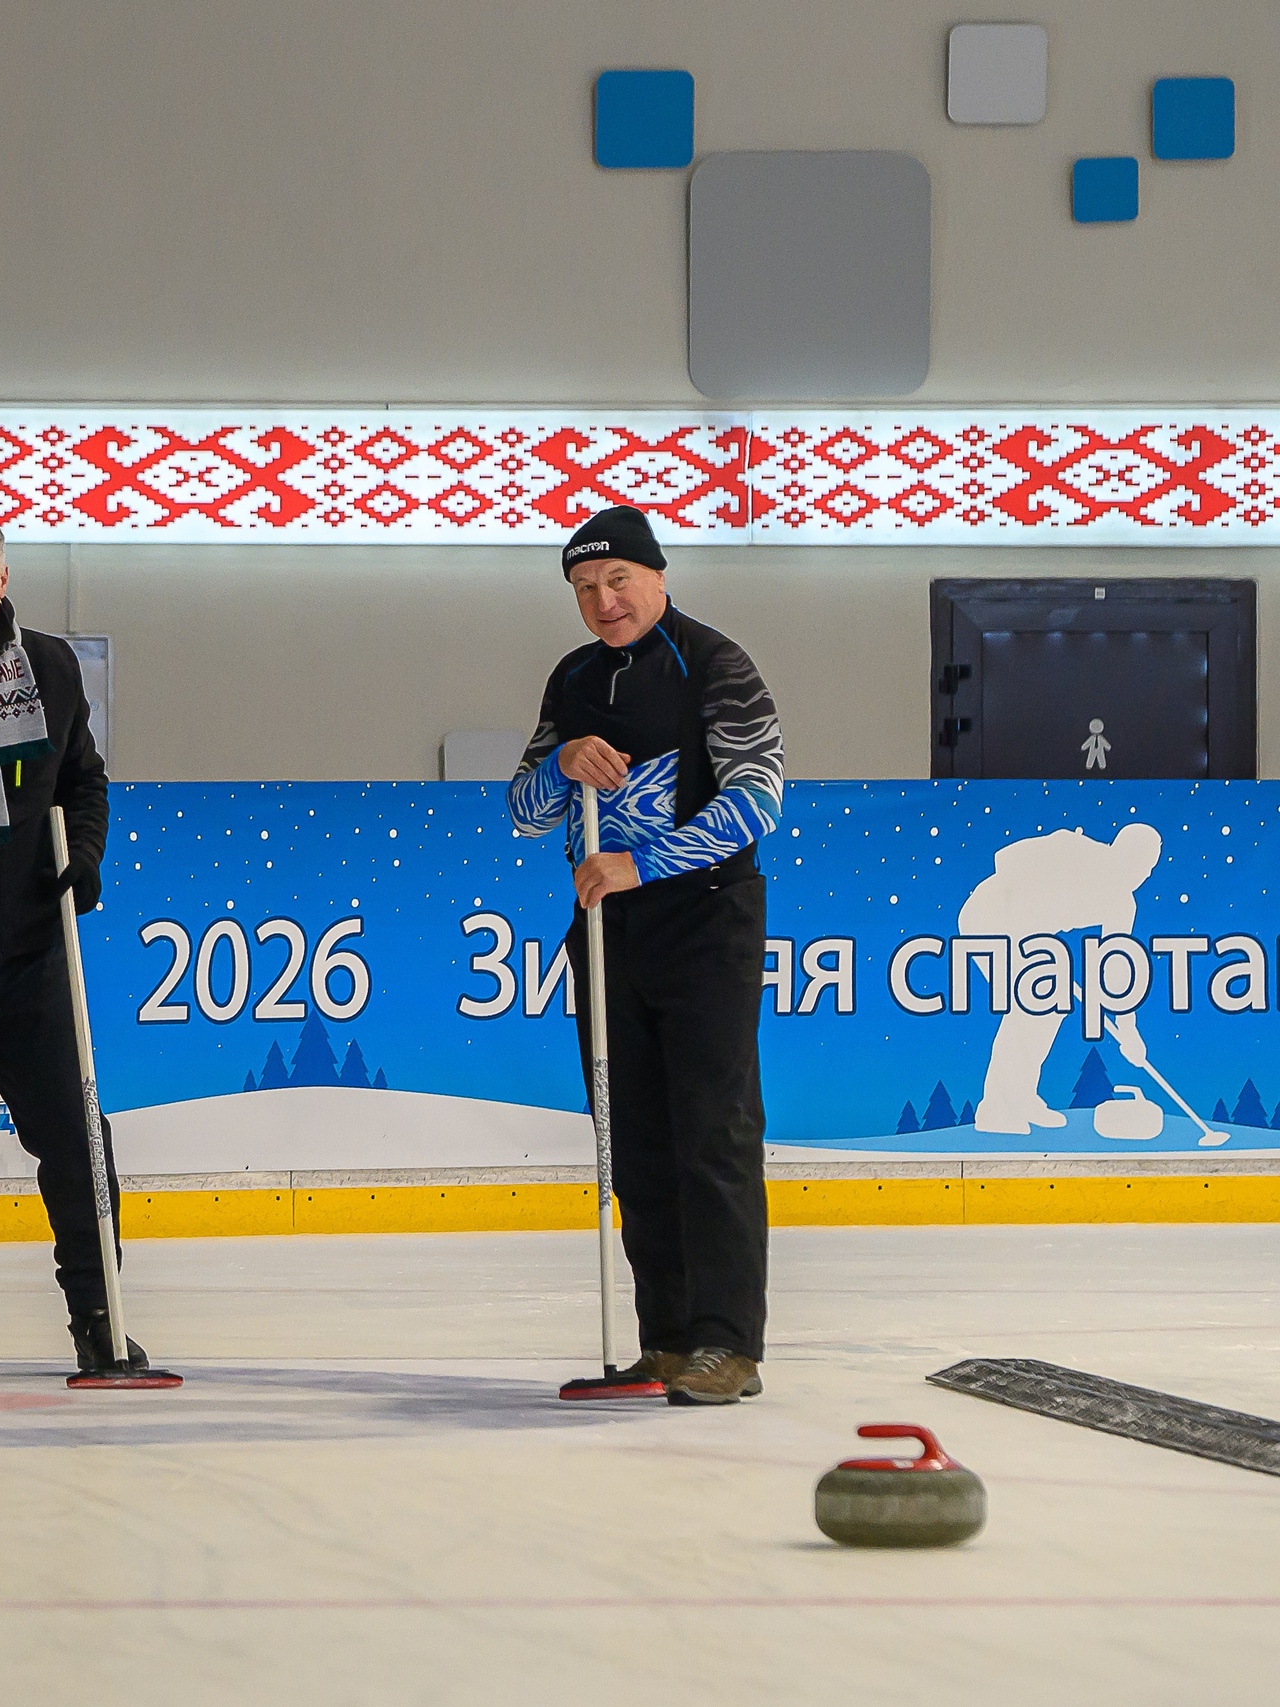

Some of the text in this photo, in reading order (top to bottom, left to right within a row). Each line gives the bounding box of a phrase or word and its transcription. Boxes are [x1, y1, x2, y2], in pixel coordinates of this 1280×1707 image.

[566, 541, 610, 560] macron
[137, 915, 371, 1025] 2026
[456, 910, 1280, 1042] Зияя спарта
